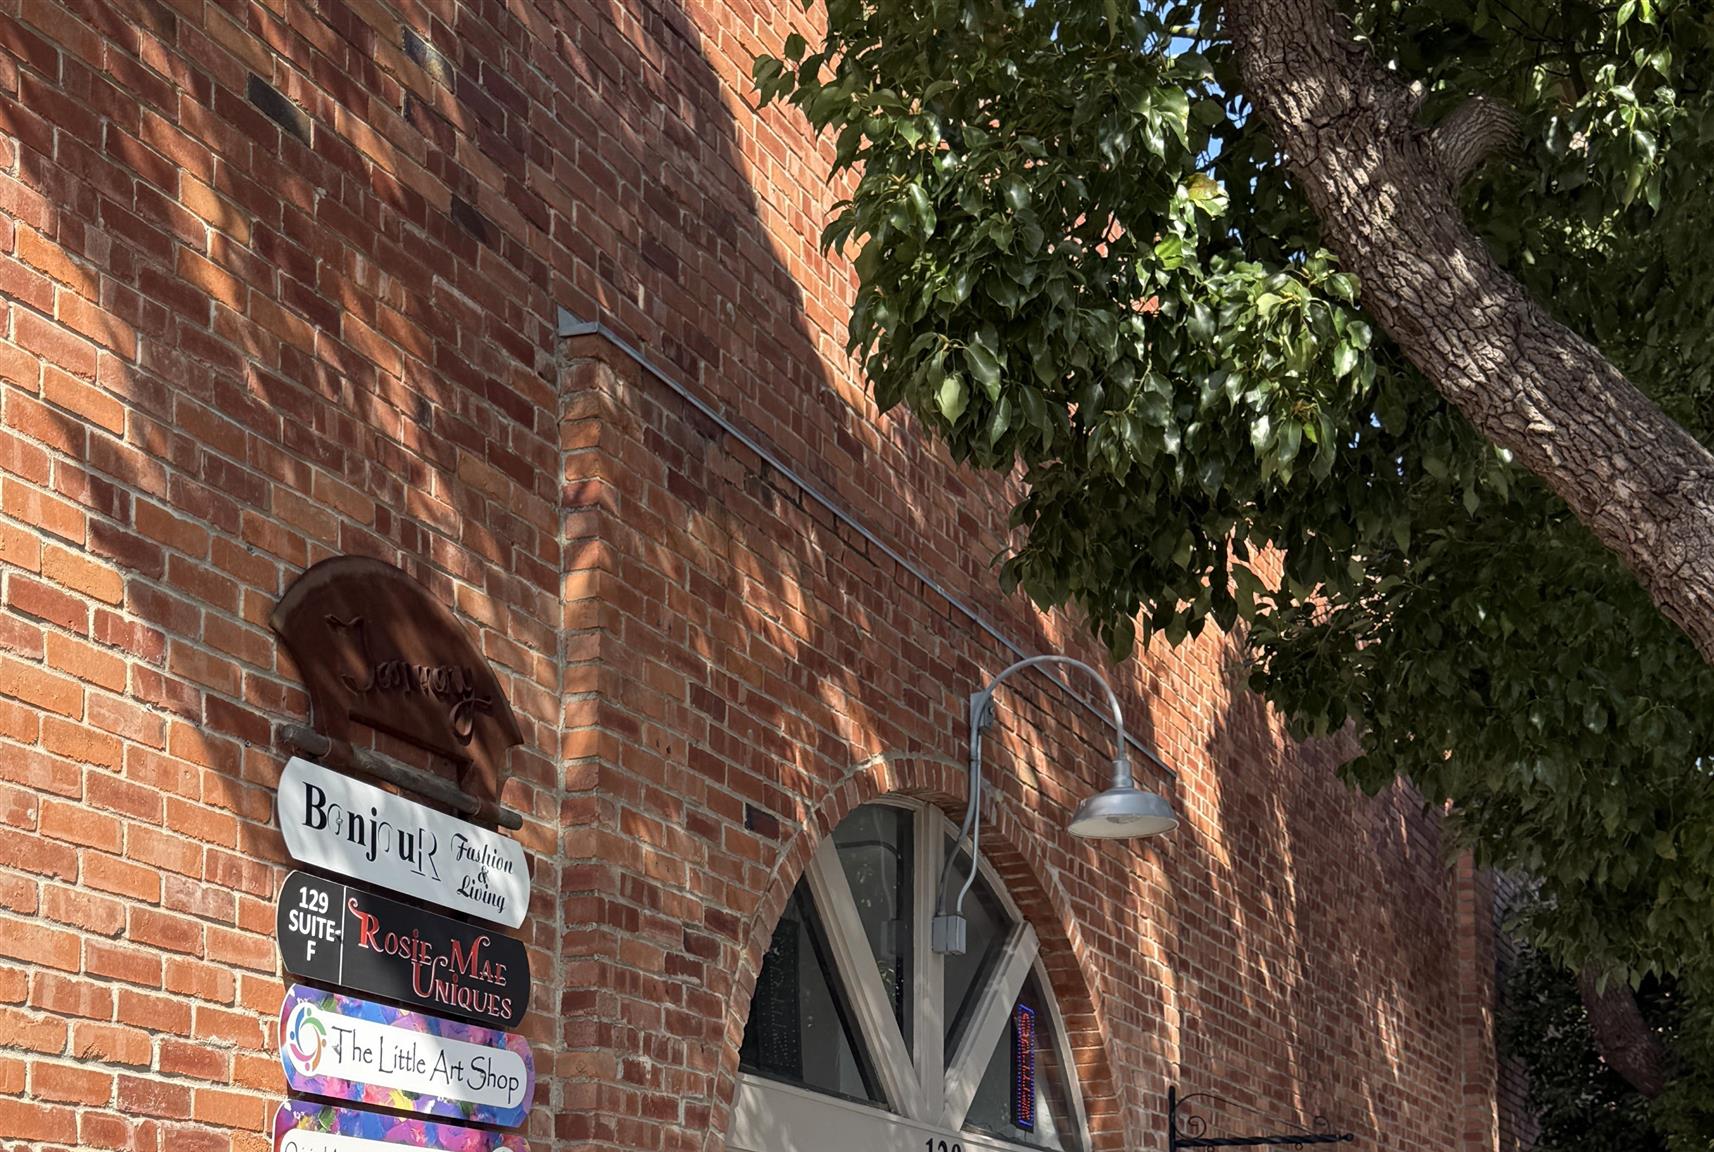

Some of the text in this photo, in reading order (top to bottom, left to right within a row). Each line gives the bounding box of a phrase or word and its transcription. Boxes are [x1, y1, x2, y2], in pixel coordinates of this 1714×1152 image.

[451, 833, 513, 874] Fashion
[478, 866, 490, 882] &
[299, 886, 329, 914] 129
[457, 875, 505, 914] Living
[306, 940, 317, 961] F
[331, 1025, 519, 1103] The Little Art Shop
